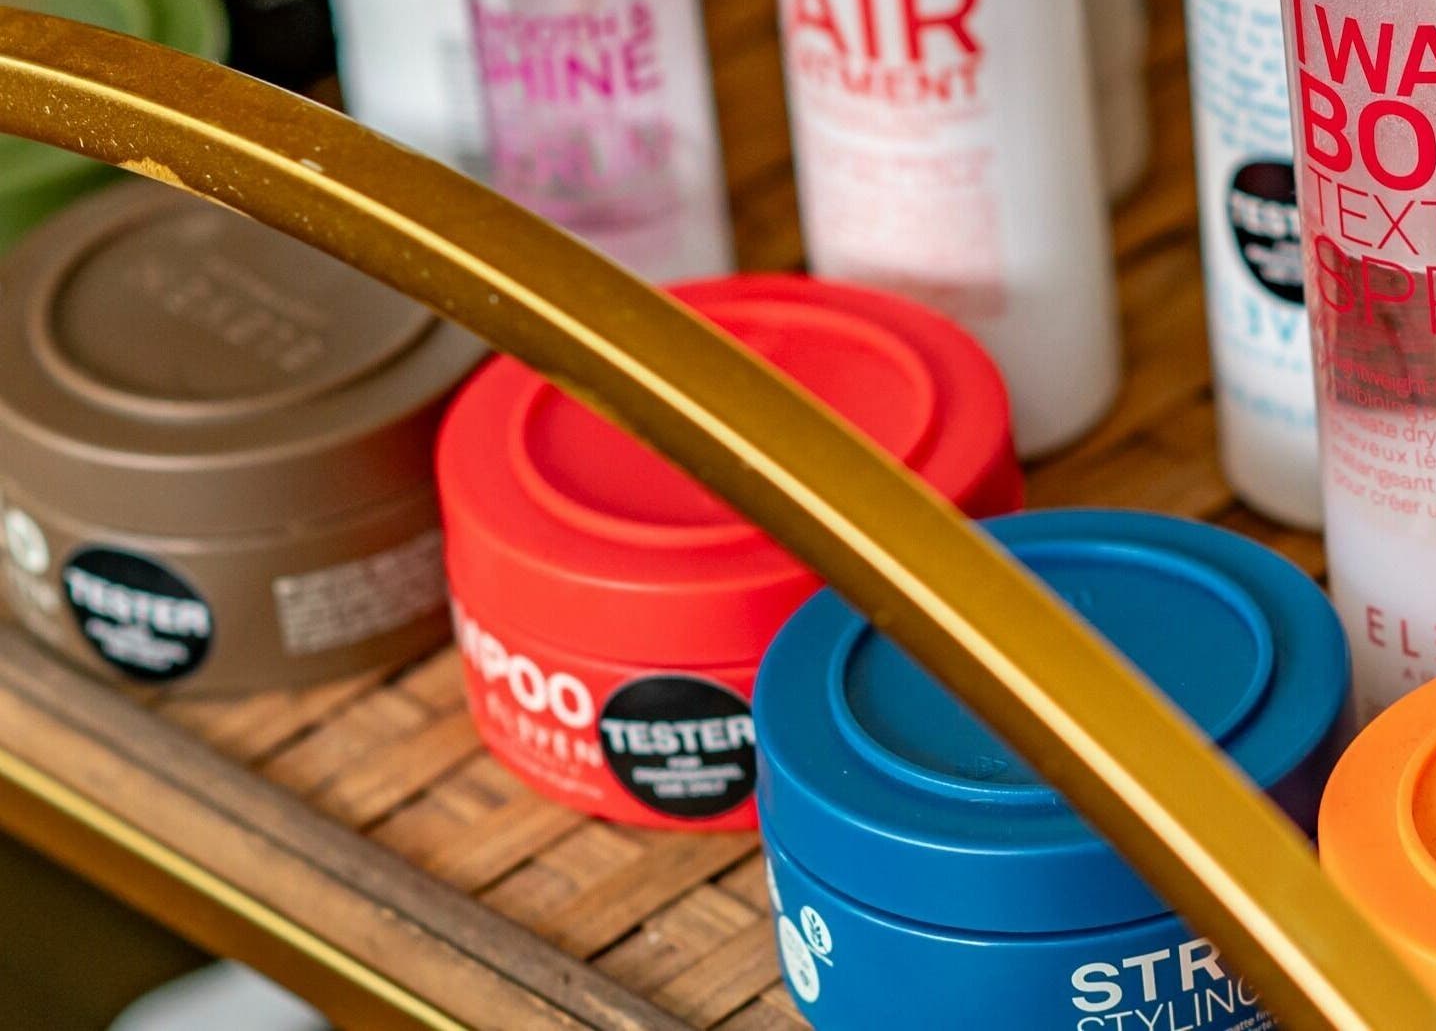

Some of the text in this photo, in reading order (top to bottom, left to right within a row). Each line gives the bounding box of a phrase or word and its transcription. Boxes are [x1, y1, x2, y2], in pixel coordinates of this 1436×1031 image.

[1402, 424, 1436, 449] dry
[63, 566, 212, 638] TESTER
[599, 713, 757, 755] TESTER
[1070, 936, 1226, 1013] STR
